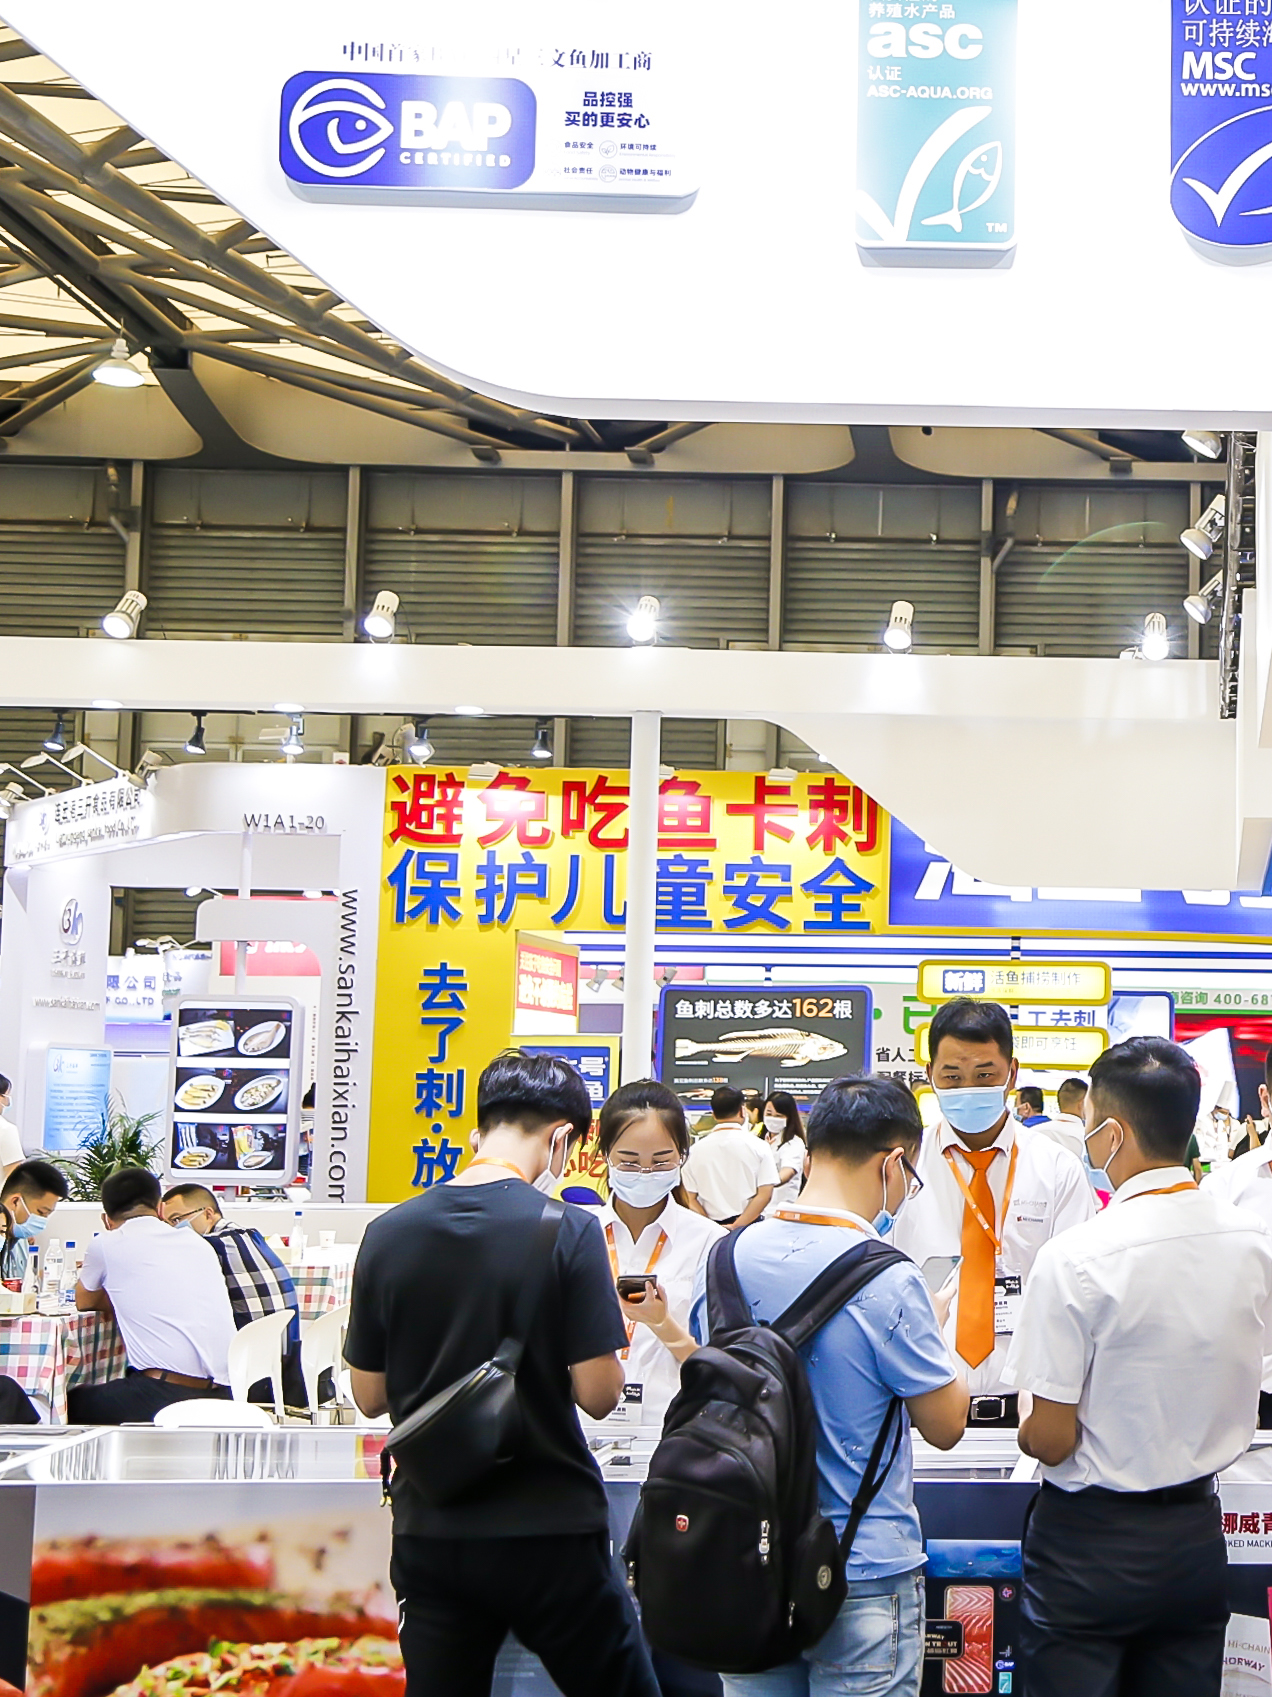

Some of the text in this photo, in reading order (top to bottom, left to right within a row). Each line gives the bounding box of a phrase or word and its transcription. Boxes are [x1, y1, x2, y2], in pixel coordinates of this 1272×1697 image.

[868, 2, 956, 19] 养殖水产品
[867, 21, 983, 60] asc
[867, 65, 902, 81] 认证
[1181, 51, 1257, 81] MSC
[582, 91, 634, 108] 品控强
[867, 84, 993, 100] ASC-AQUA.ORG
[400, 99, 513, 152] BAP
[564, 111, 650, 129] 买的更安心
[399, 152, 512, 168] CERTIFIED
[388, 770, 879, 853] 避免吃鱼卡刺
[243, 813, 326, 831] W1A1-20
[386, 847, 877, 933] 保护儿童安全
[674, 998, 853, 1020] 鱼刺总数多达162根
[328, 888, 359, 1203] www.sankaihaixian.com
[1226, 1540, 1245, 1548] KED
